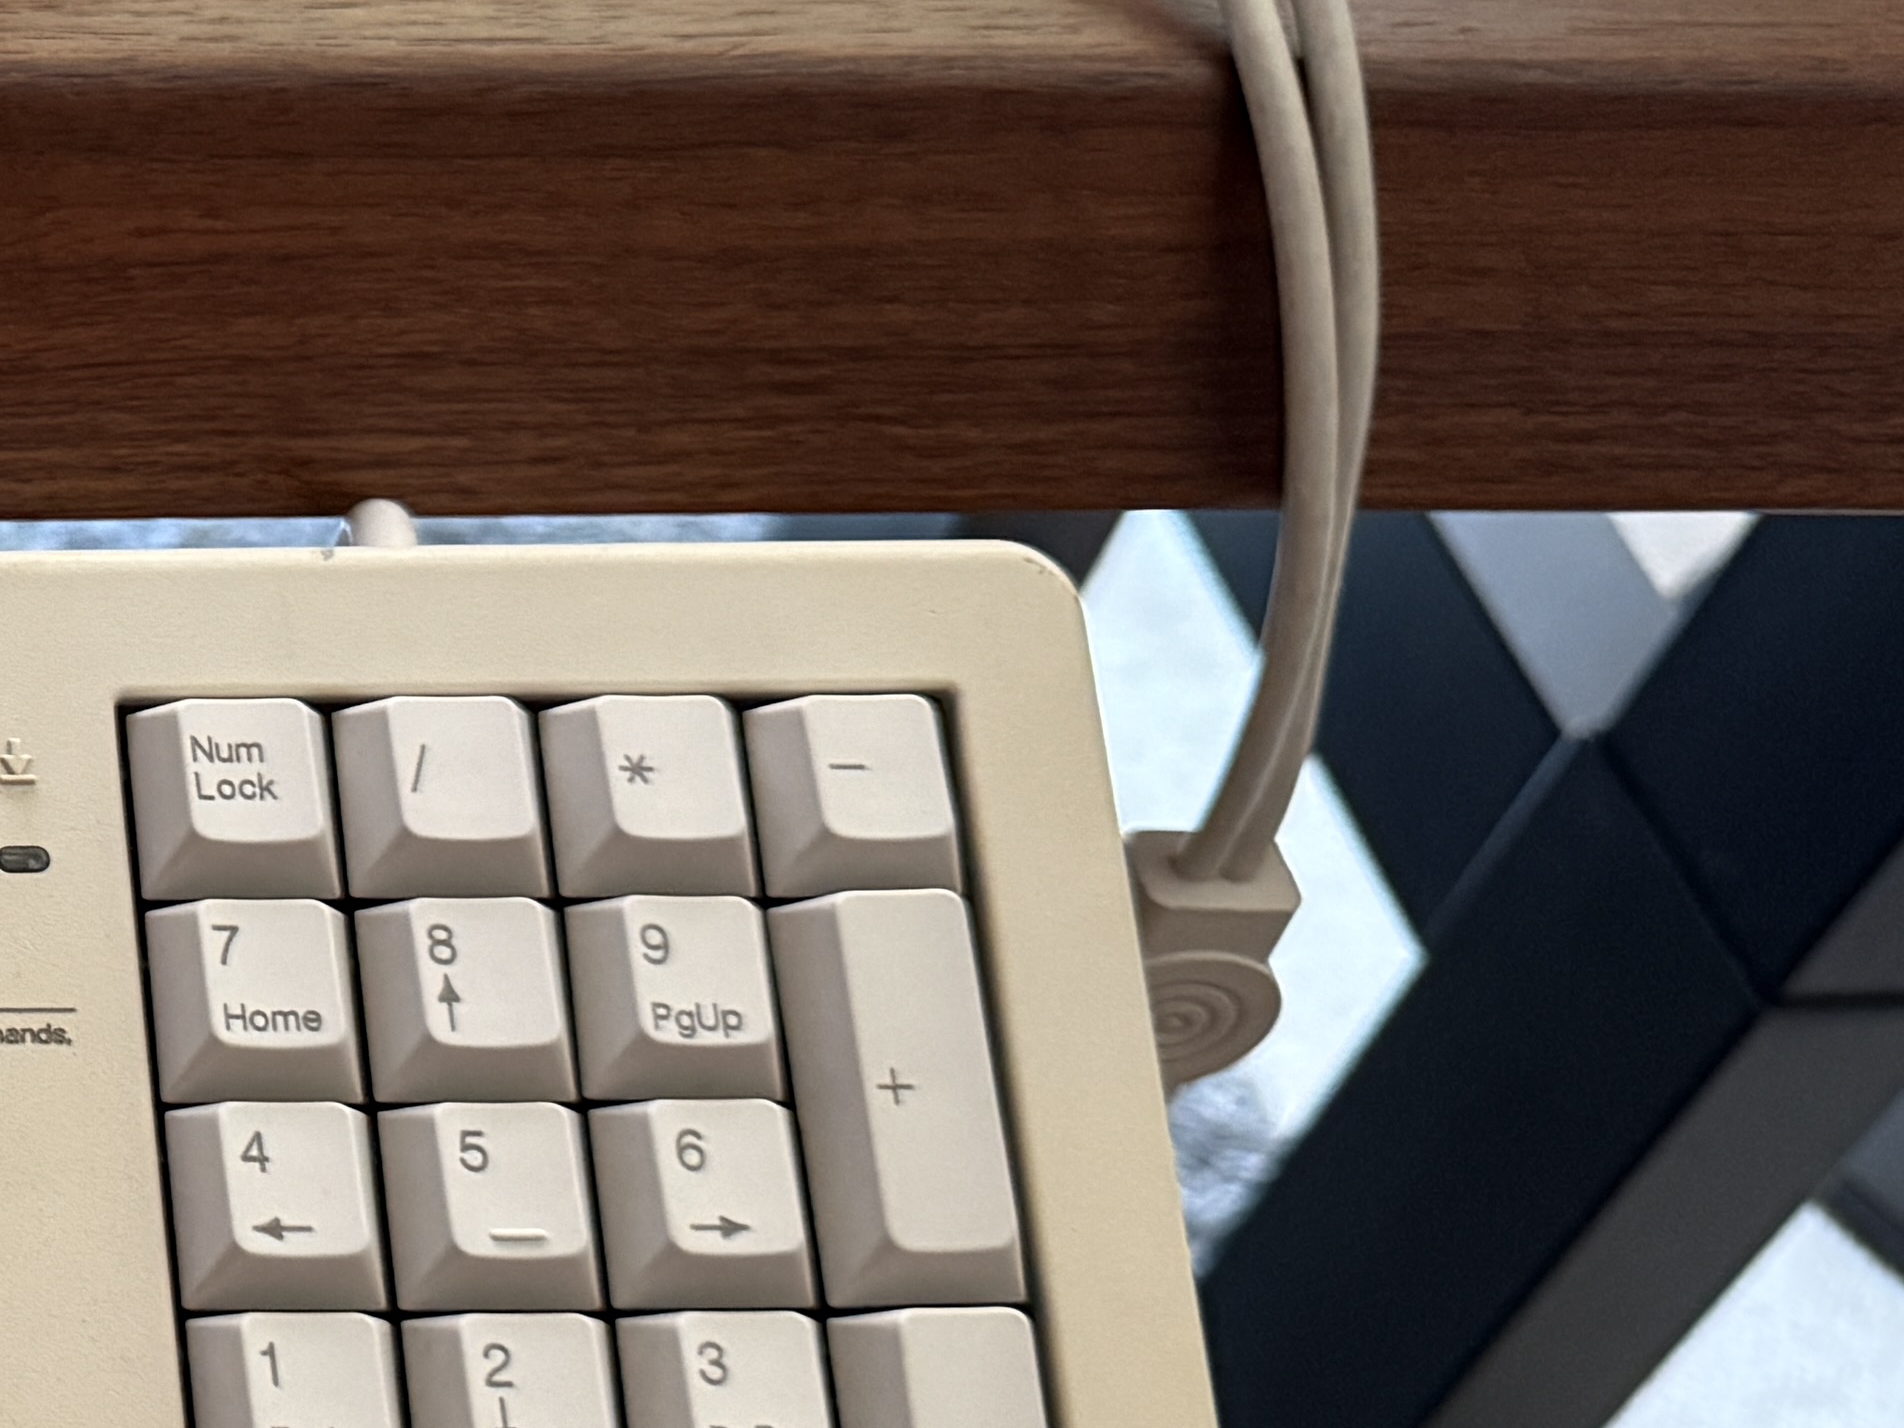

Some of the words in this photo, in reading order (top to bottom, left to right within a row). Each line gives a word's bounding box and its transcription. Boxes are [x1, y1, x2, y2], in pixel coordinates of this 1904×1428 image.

[189, 735, 265, 764] Num
[193, 771, 279, 802] Lock
[211, 924, 240, 966] 7
[426, 923, 458, 966] 8
[639, 923, 671, 966] 9
[223, 1002, 323, 1033] Home
[650, 1001, 744, 1040] PgUp
[240, 1130, 270, 1174] 4
[459, 1129, 489, 1174] 5
[675, 1128, 707, 1173] 6
[259, 1341, 280, 1388] 1
[482, 1342, 515, 1389] 2
[697, 1340, 729, 1387] 3
